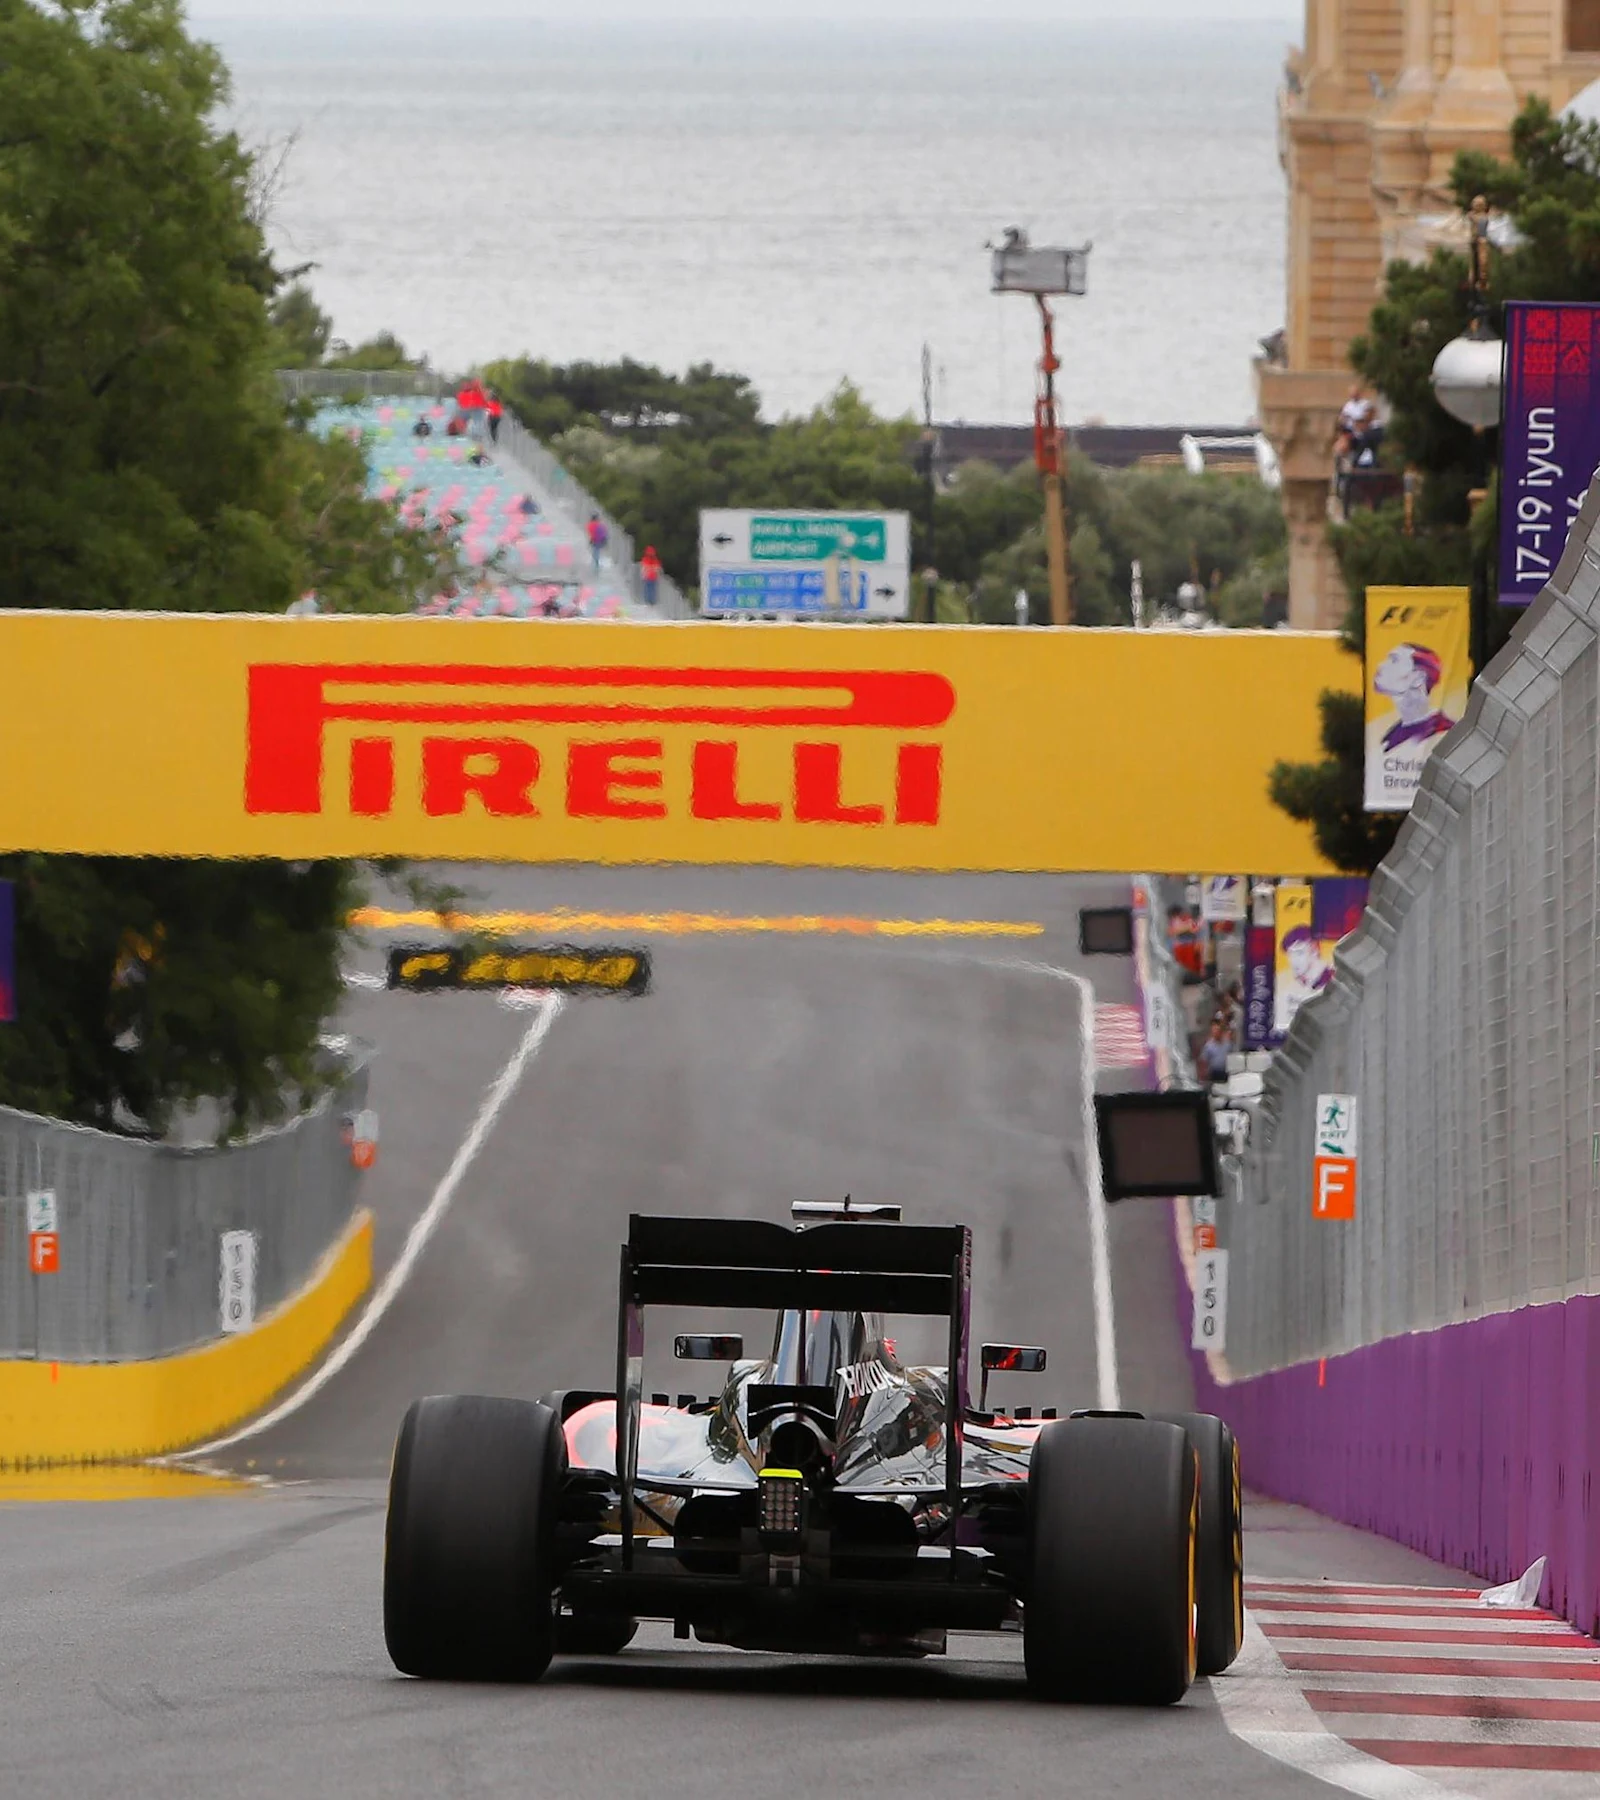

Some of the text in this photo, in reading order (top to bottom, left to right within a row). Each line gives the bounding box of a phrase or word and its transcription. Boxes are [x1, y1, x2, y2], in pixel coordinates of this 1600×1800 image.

[1515, 406, 1564, 583] 17-19 iyun
[245, 663, 957, 827] PIRELLI
[1383, 774, 1420, 789] Brow
[1319, 1131, 1349, 1140] EXIT
[1318, 1163, 1350, 1212] F
[34, 1236, 55, 1266] F
[1202, 1260, 1217, 1337] 150
